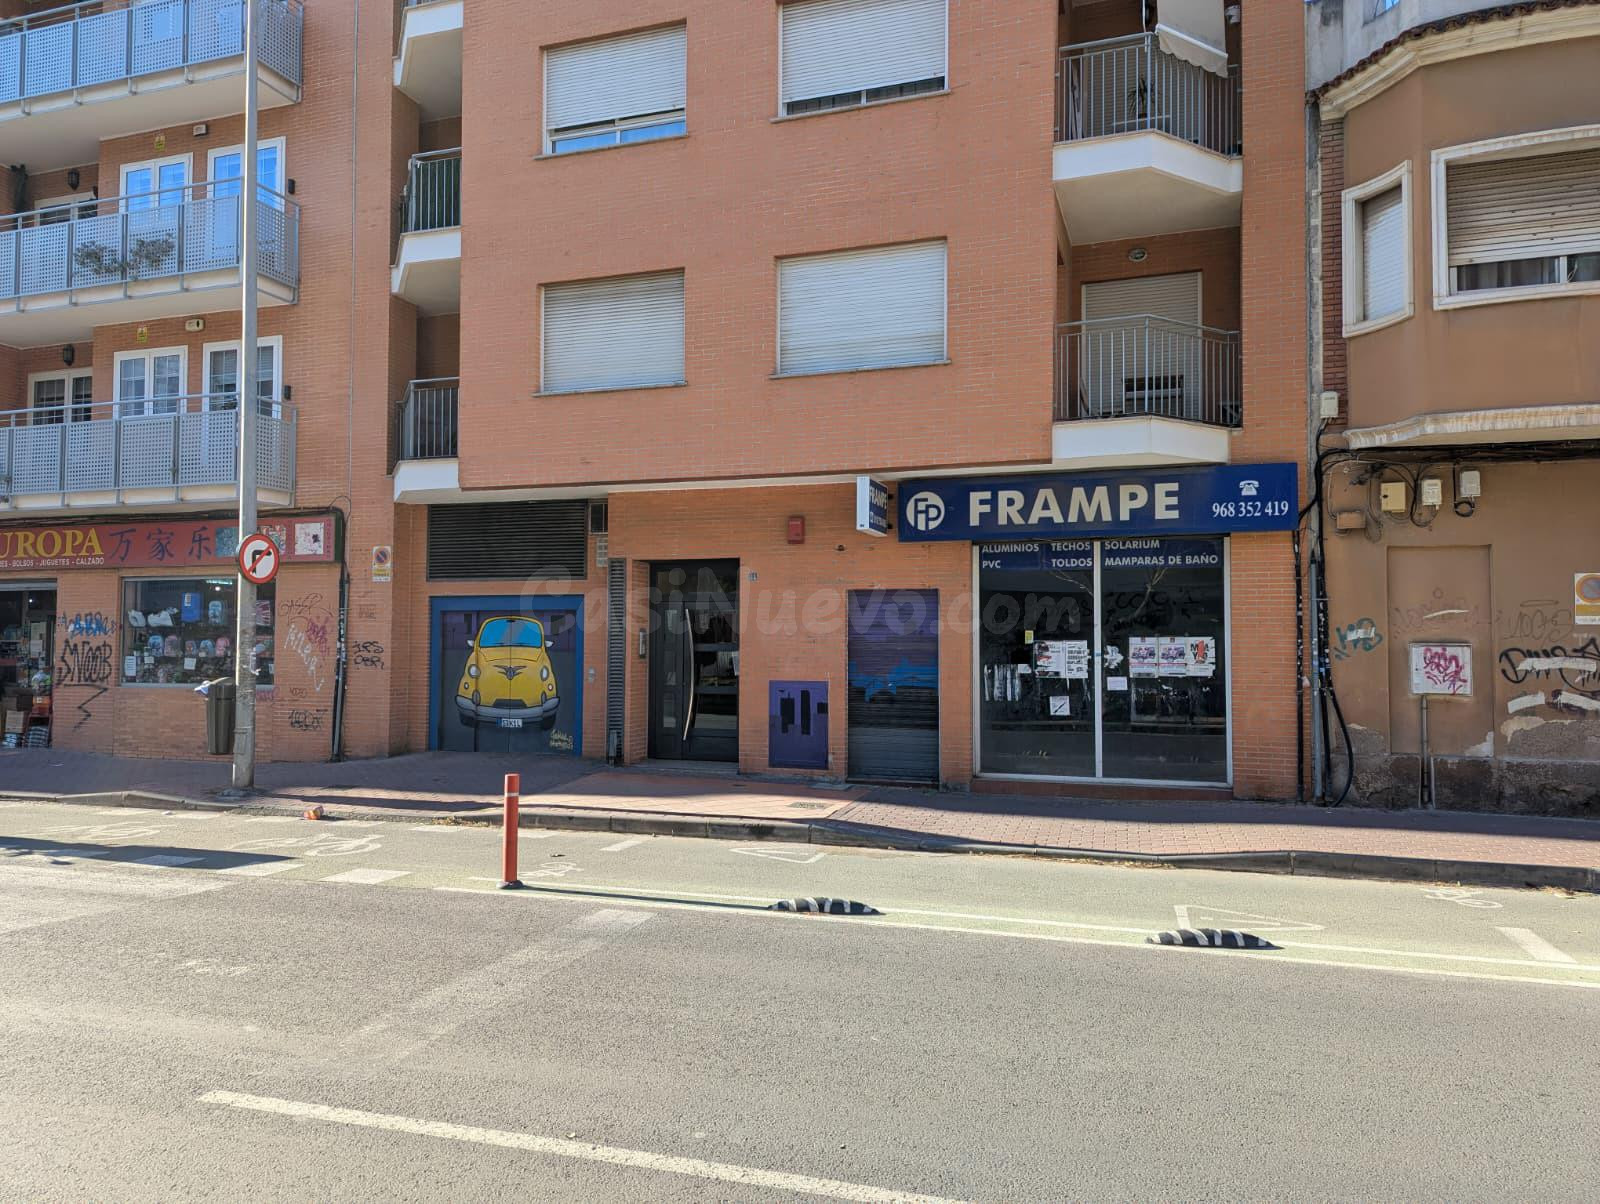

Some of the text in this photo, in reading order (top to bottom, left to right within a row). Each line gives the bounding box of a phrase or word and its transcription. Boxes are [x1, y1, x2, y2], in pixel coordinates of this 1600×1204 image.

[969, 482, 1180, 527] FRAMPE
[1212, 500, 1289, 518] 968 352 419
[109, 525, 212, 562] 万家乐
[982, 541, 1091, 553] ALUMINIOS TECHOS
[1104, 539, 1160, 550] SOLARIUM
[12, 559, 34, 568] BOLSOS
[39, 558, 70, 566] JUGUETES
[76, 557, 104, 565] CALZADO
[982, 557, 1093, 569] PVC TOLDOS
[1104, 552, 1219, 566] MAMPARAS DE BAÑO
